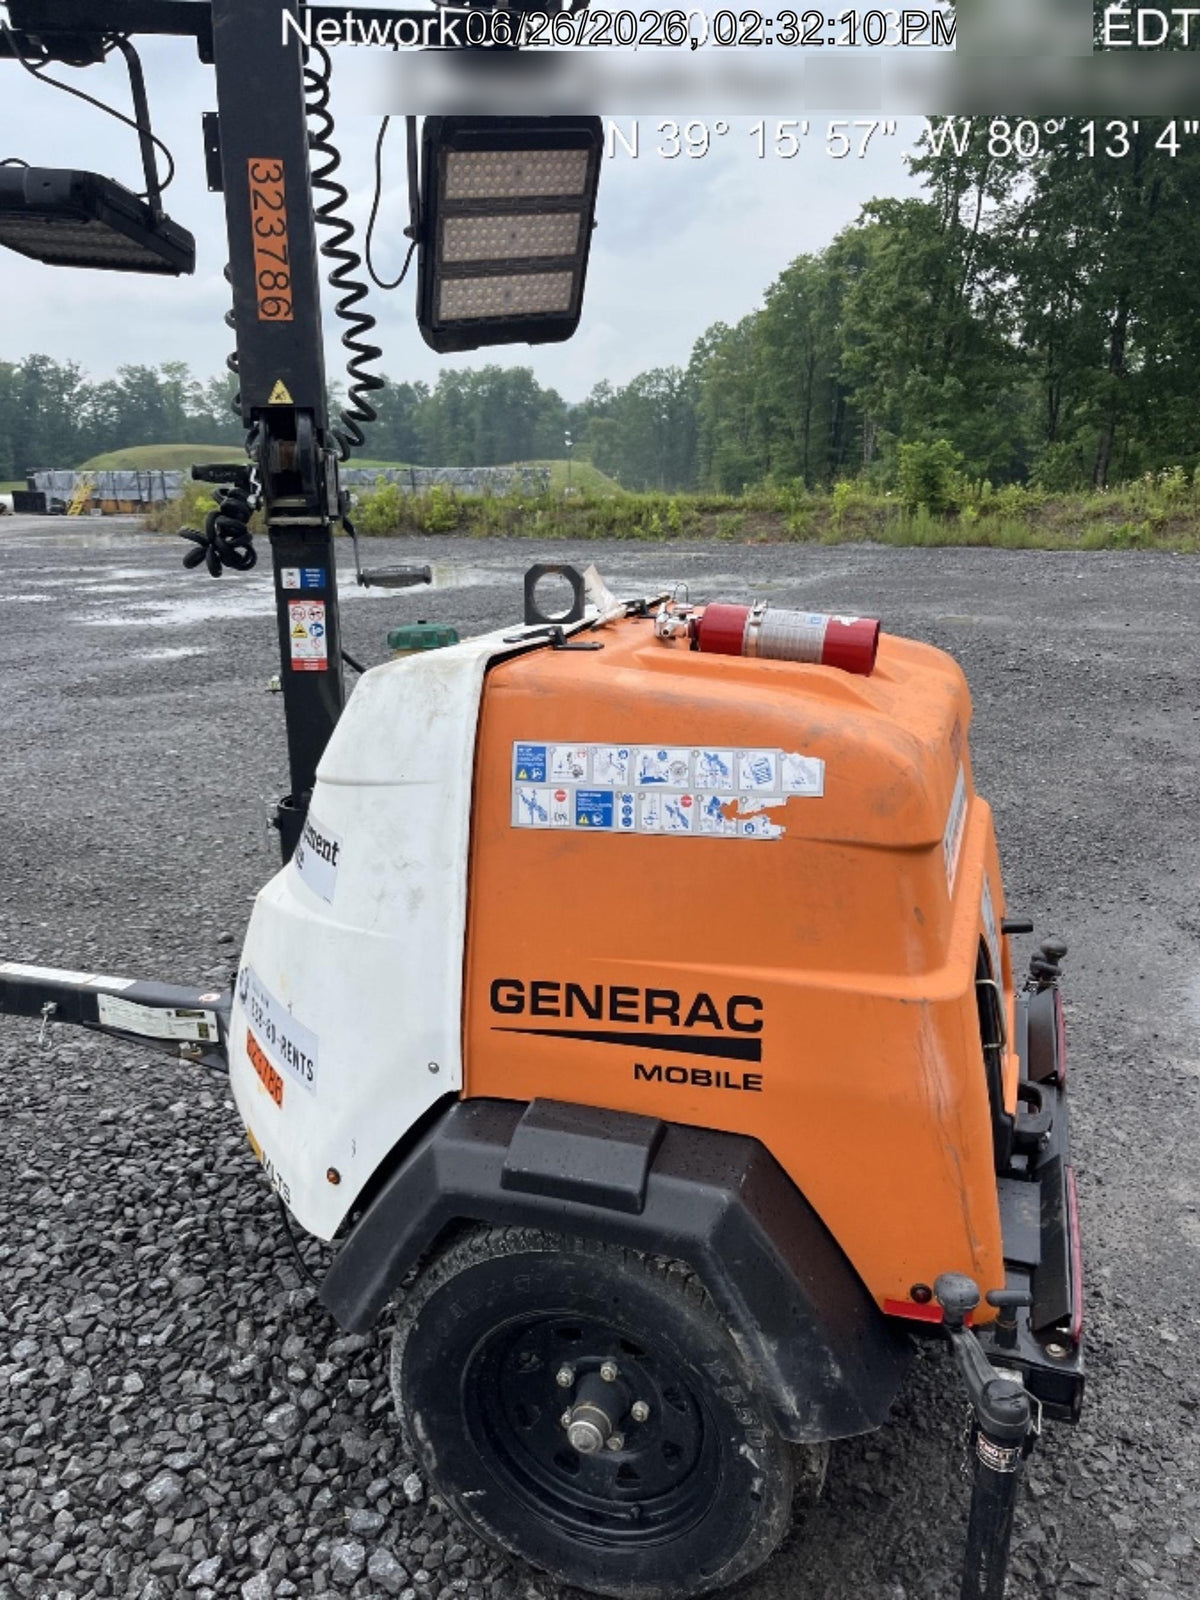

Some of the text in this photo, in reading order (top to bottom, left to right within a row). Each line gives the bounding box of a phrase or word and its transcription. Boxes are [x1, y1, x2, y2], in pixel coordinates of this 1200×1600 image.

[251, 162, 292, 318] 323786
[489, 978, 764, 1034] GENERAC
[633, 1063, 763, 1092] MOBILE
